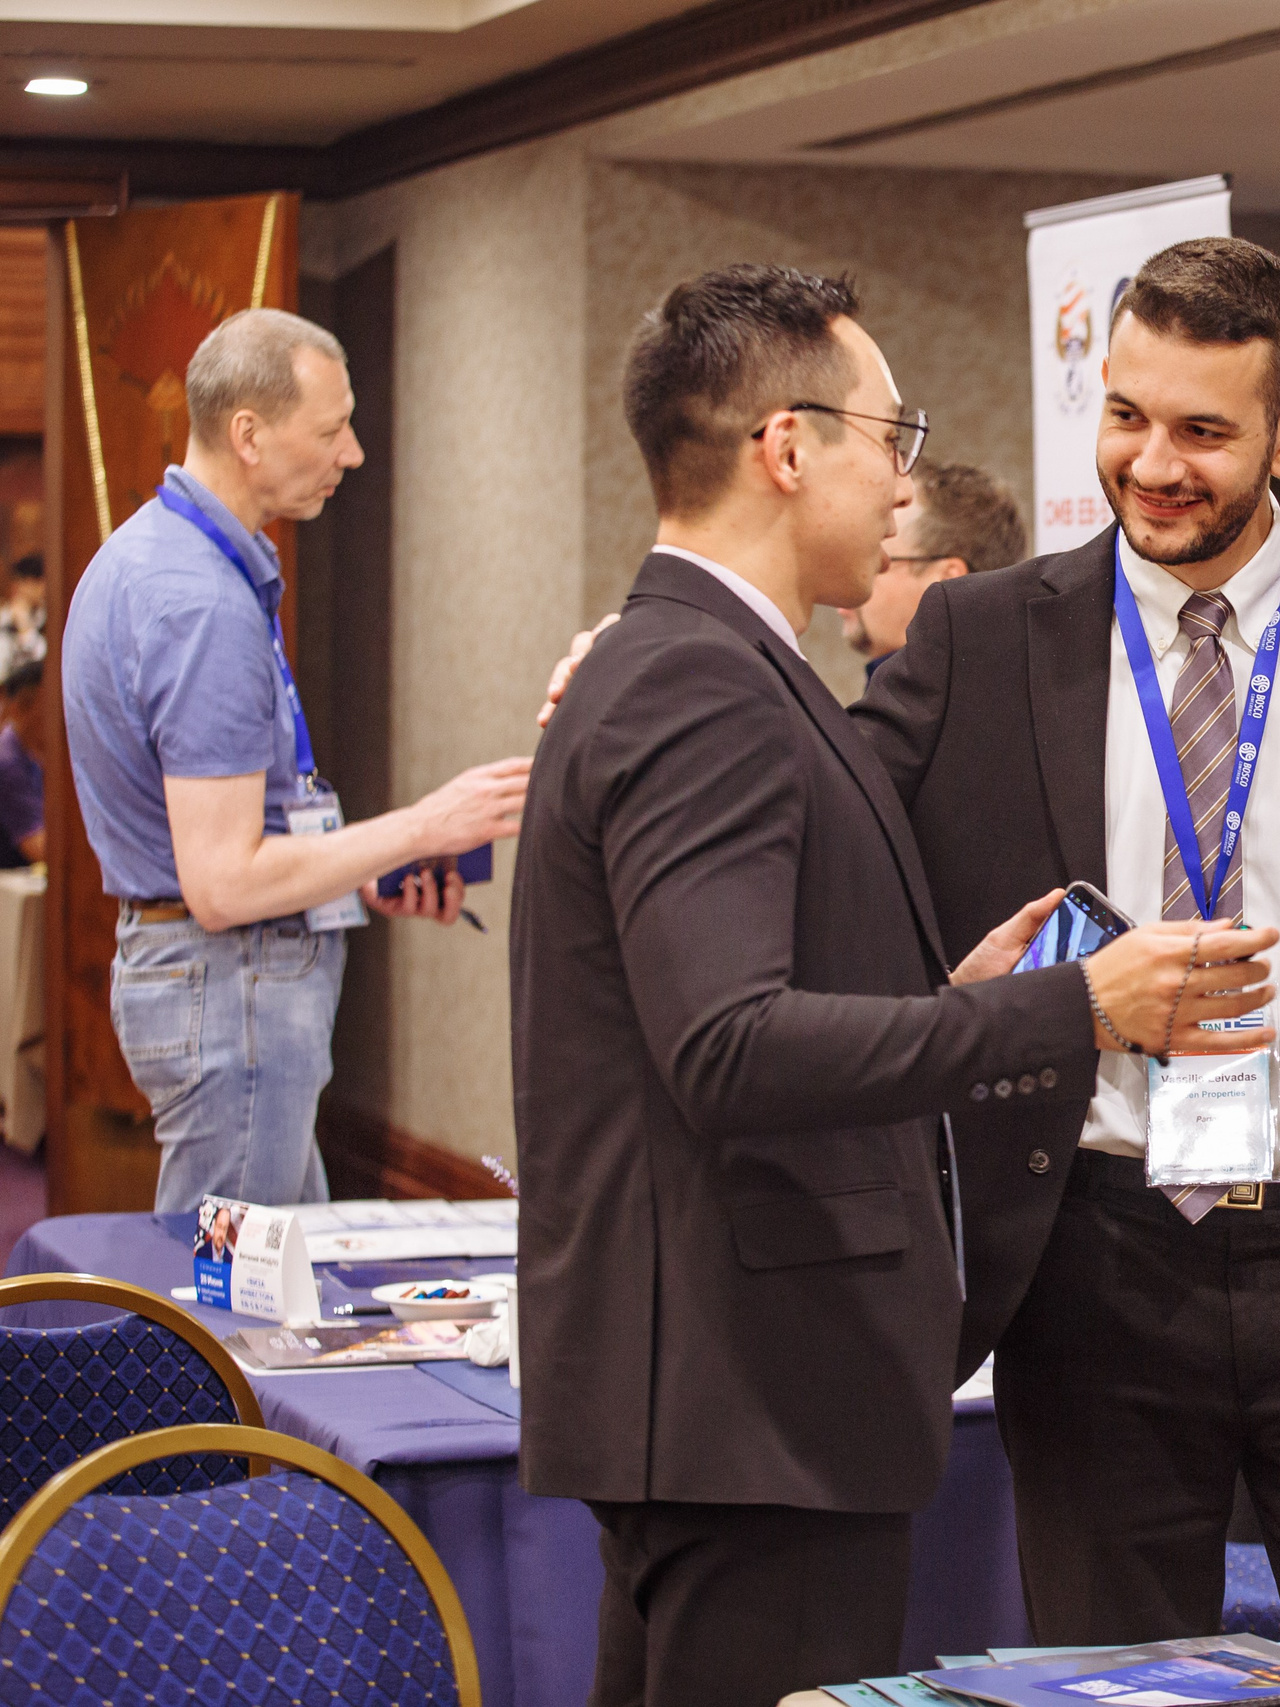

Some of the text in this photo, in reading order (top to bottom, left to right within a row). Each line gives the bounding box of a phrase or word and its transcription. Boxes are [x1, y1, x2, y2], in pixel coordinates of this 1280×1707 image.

[1265, 628, 1276, 650] BOSCO
[1253, 694, 1266, 719] BOSCO
[1240, 762, 1252, 788] BOSCO
[1226, 831, 1237, 856] BOSCO
[1197, 1022, 1222, 1032] TAN
[1208, 1072, 1257, 1084] eivadas
[1201, 1089, 1246, 1099] Properties
